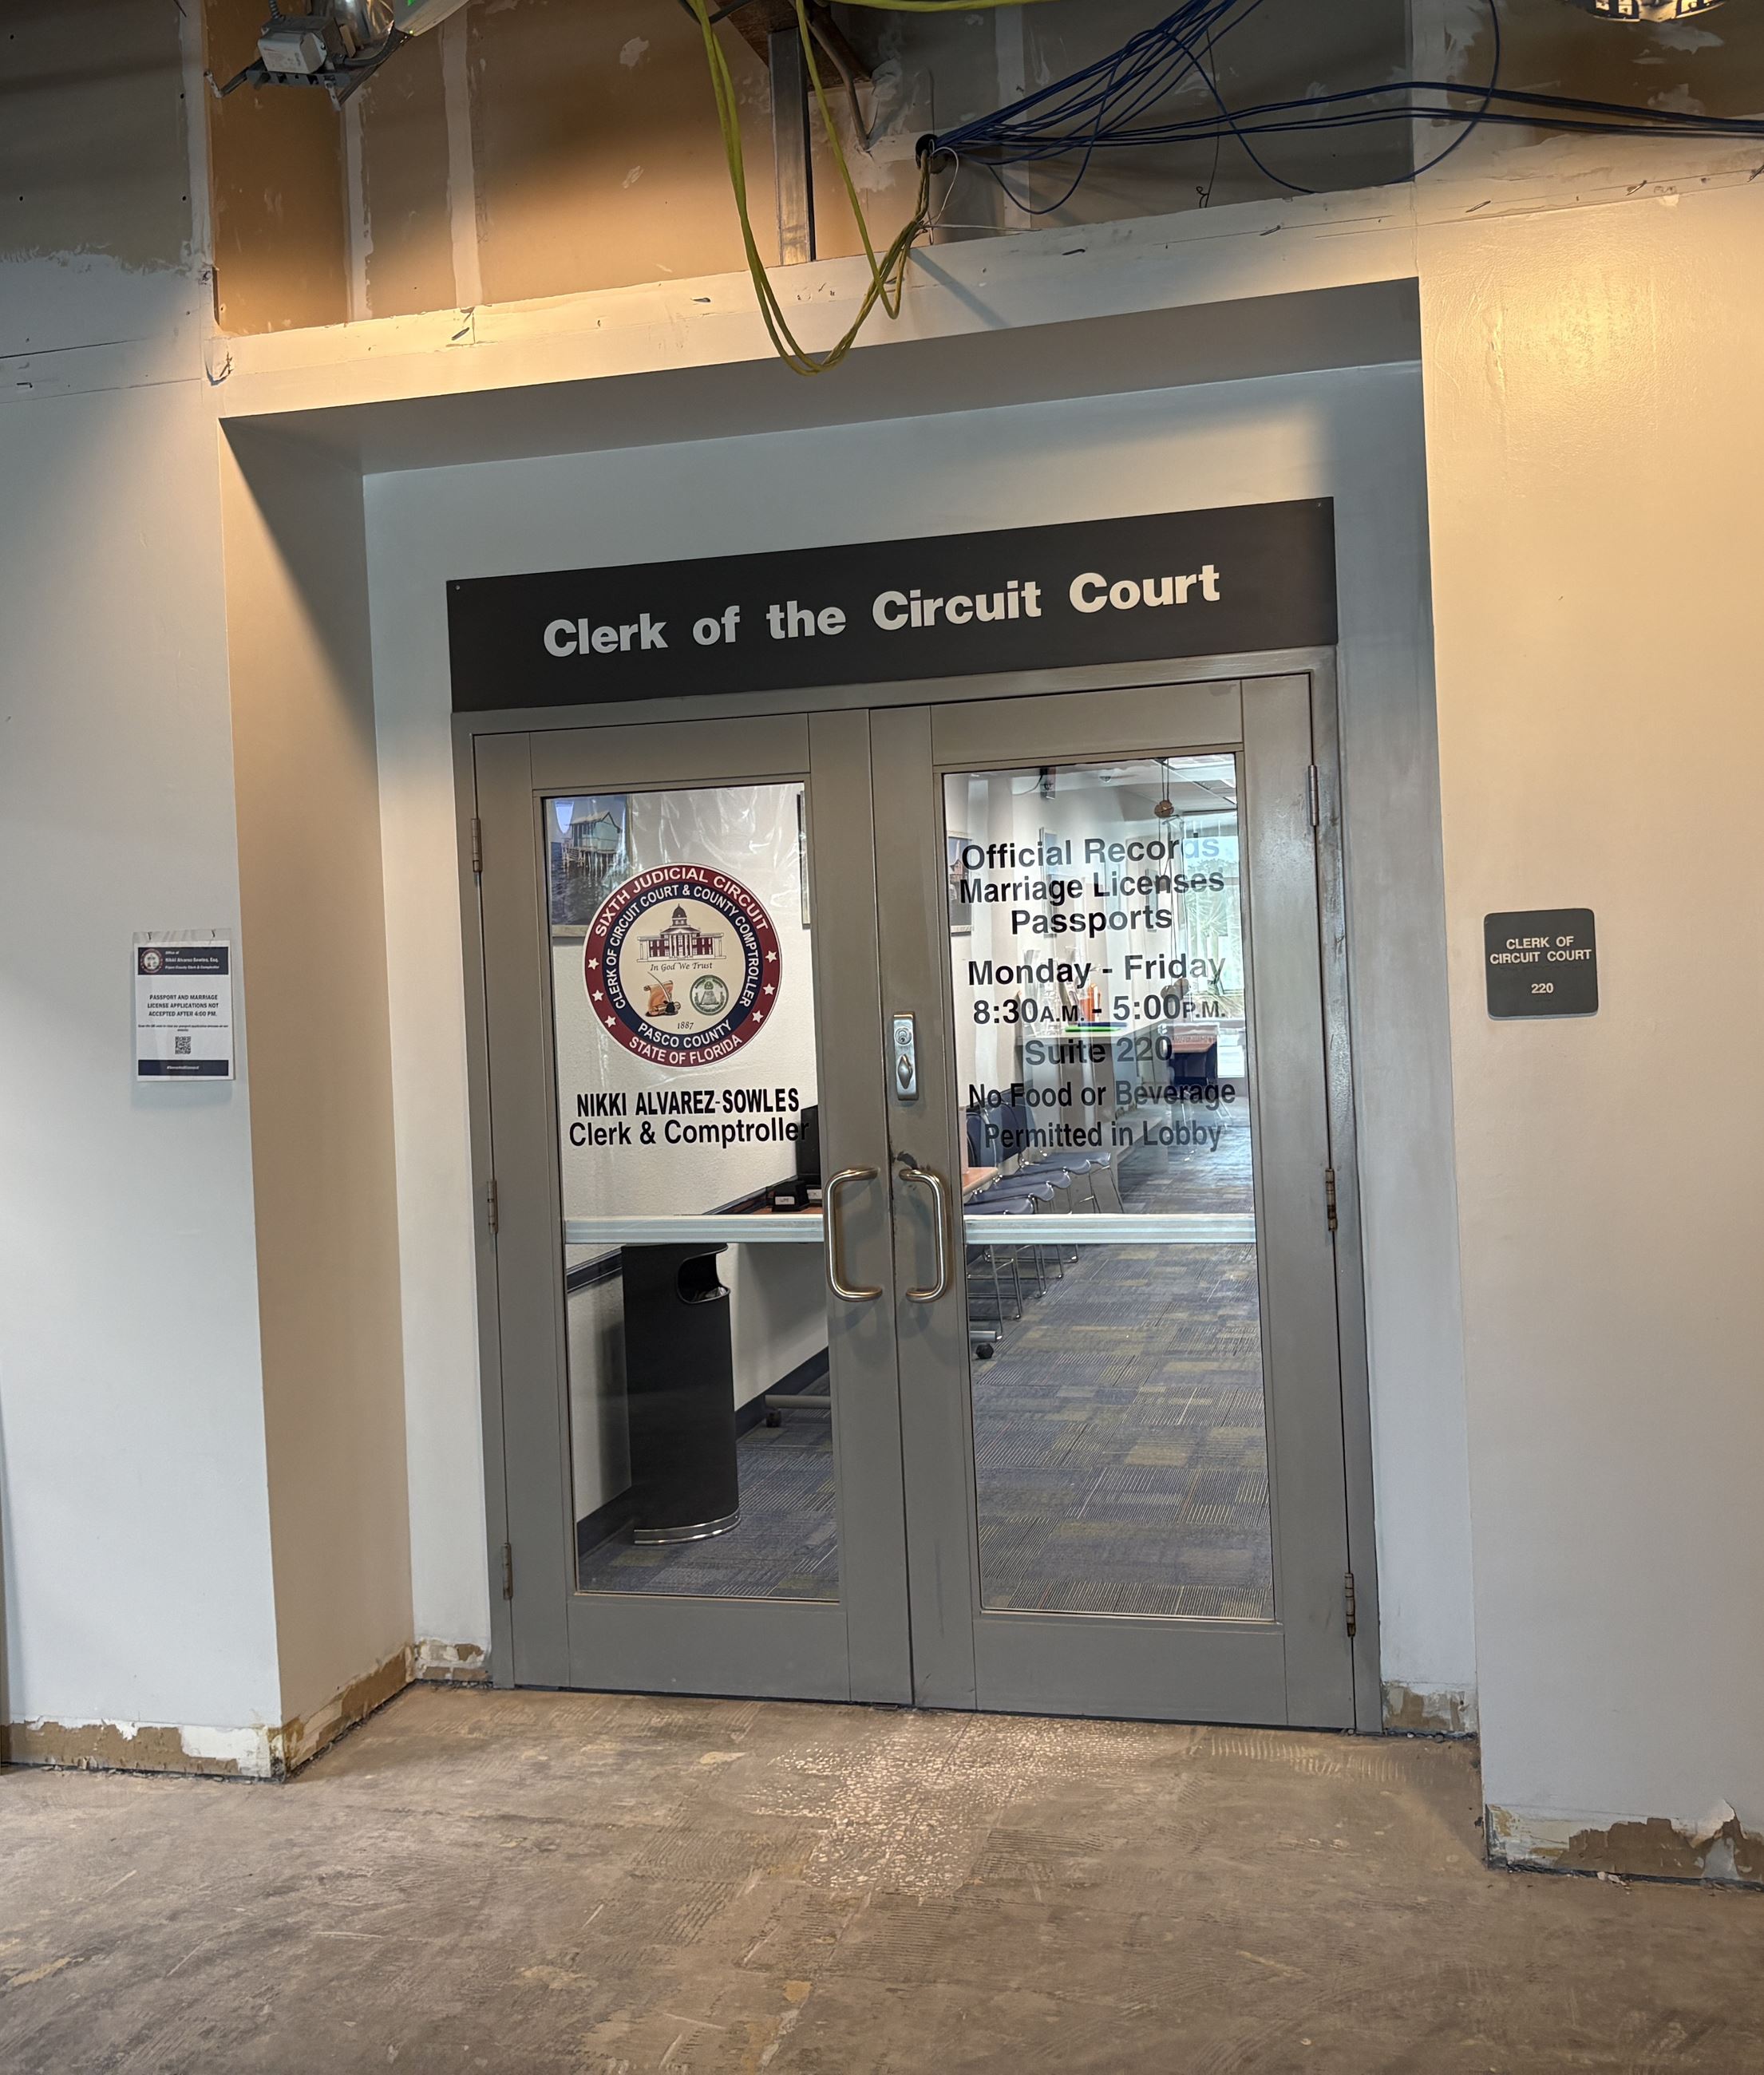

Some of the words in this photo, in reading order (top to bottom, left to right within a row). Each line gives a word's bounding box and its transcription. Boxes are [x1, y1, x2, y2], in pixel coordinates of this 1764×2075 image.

[544, 613, 668, 657] Clerk
[692, 605, 741, 646] of
[765, 600, 846, 639] the
[872, 579, 1042, 630] Circuit
[1069, 564, 1220, 614] Court
[961, 839, 1071, 870] Official
[1085, 837, 1220, 864] Records
[595, 890, 631, 937] SIXTH
[633, 868, 708, 894] JUDICIAL
[714, 875, 769, 930] CIRCUIT
[639, 885, 679, 907] COURT
[682, 884, 690, 895] &
[694, 886, 739, 916] COUNTY
[960, 878, 1083, 907] Marriage
[1094, 871, 1224, 898] Licenses
[610, 903, 641, 947] CIRCUIT
[1011, 907, 1173, 938] Passports
[606, 948, 618, 966] OF
[1489, 951, 1541, 965] CIRCUIT
[1546, 949, 1592, 962] COURT
[1505, 937, 1550, 950] CLERK
[1556, 935, 1574, 947] OF
[661, 962, 676, 972] God
[678, 962, 690, 970] We
[692, 961, 713, 970] Trust
[735, 916, 759, 1007] COMPTROLLER
[968, 958, 1092, 989] Monday
[1124, 953, 1226, 986] Friday
[607, 968, 626, 1009] CLERK
[1531, 982, 1554, 994] 220
[638, 1022, 679, 1048] PASCO
[683, 1019, 732, 1048] COUNTY
[677, 1021, 695, 1030] 1887
[629, 1036, 666, 1061] STATE
[669, 1051, 686, 1065] OF
[689, 1034, 743, 1064] FLORIDA
[1025, 1039, 1106, 1066] Suite
[1117, 1037, 1173, 1063] 220
[576, 1093, 627, 1117] NIKKI
[635, 1088, 799, 1116] ALVAREZ-SOWLES
[968, 1083, 1003, 1109] No
[1011, 1081, 1073, 1108] Food
[1081, 1086, 1106, 1106] or
[1116, 1080, 1236, 1110] Beverage
[569, 1121, 632, 1146] Clerk
[639, 1120, 657, 1145] &
[664, 1117, 809, 1149] Comptroller
[985, 1121, 1102, 1149] Permitted
[1111, 1120, 1133, 1146] in
[1143, 1120, 1222, 1152] Lobby
